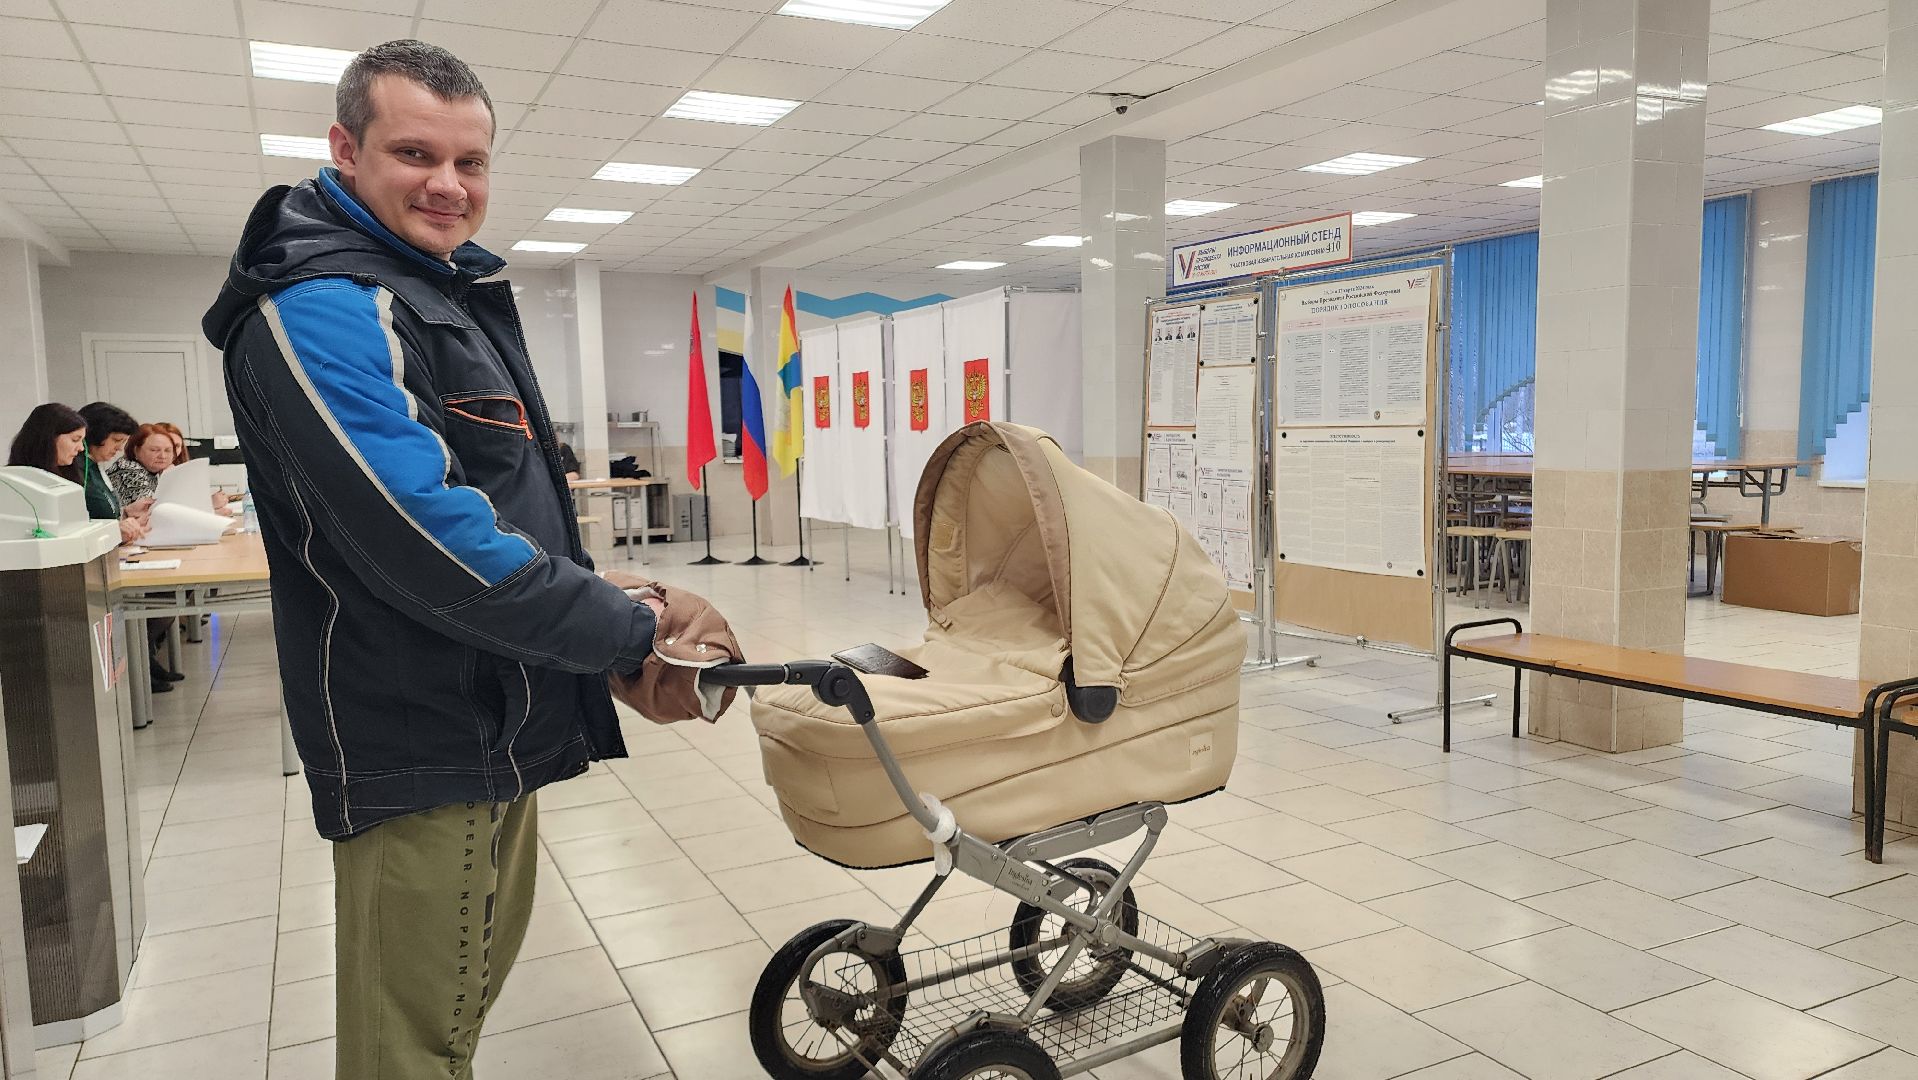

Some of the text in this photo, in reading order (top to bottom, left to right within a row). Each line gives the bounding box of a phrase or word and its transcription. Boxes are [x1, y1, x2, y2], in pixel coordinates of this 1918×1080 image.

[1227, 227, 1341, 257] ИНФОРМАЦИОННЫЙ СТЕНД
[1311, 305, 1339, 314] ПОРЯДОК
[463, 819, 475, 872] FEAR
[460, 891, 469, 916] NO
[459, 925, 469, 975] PAIN
[454, 993, 466, 1017] NO
